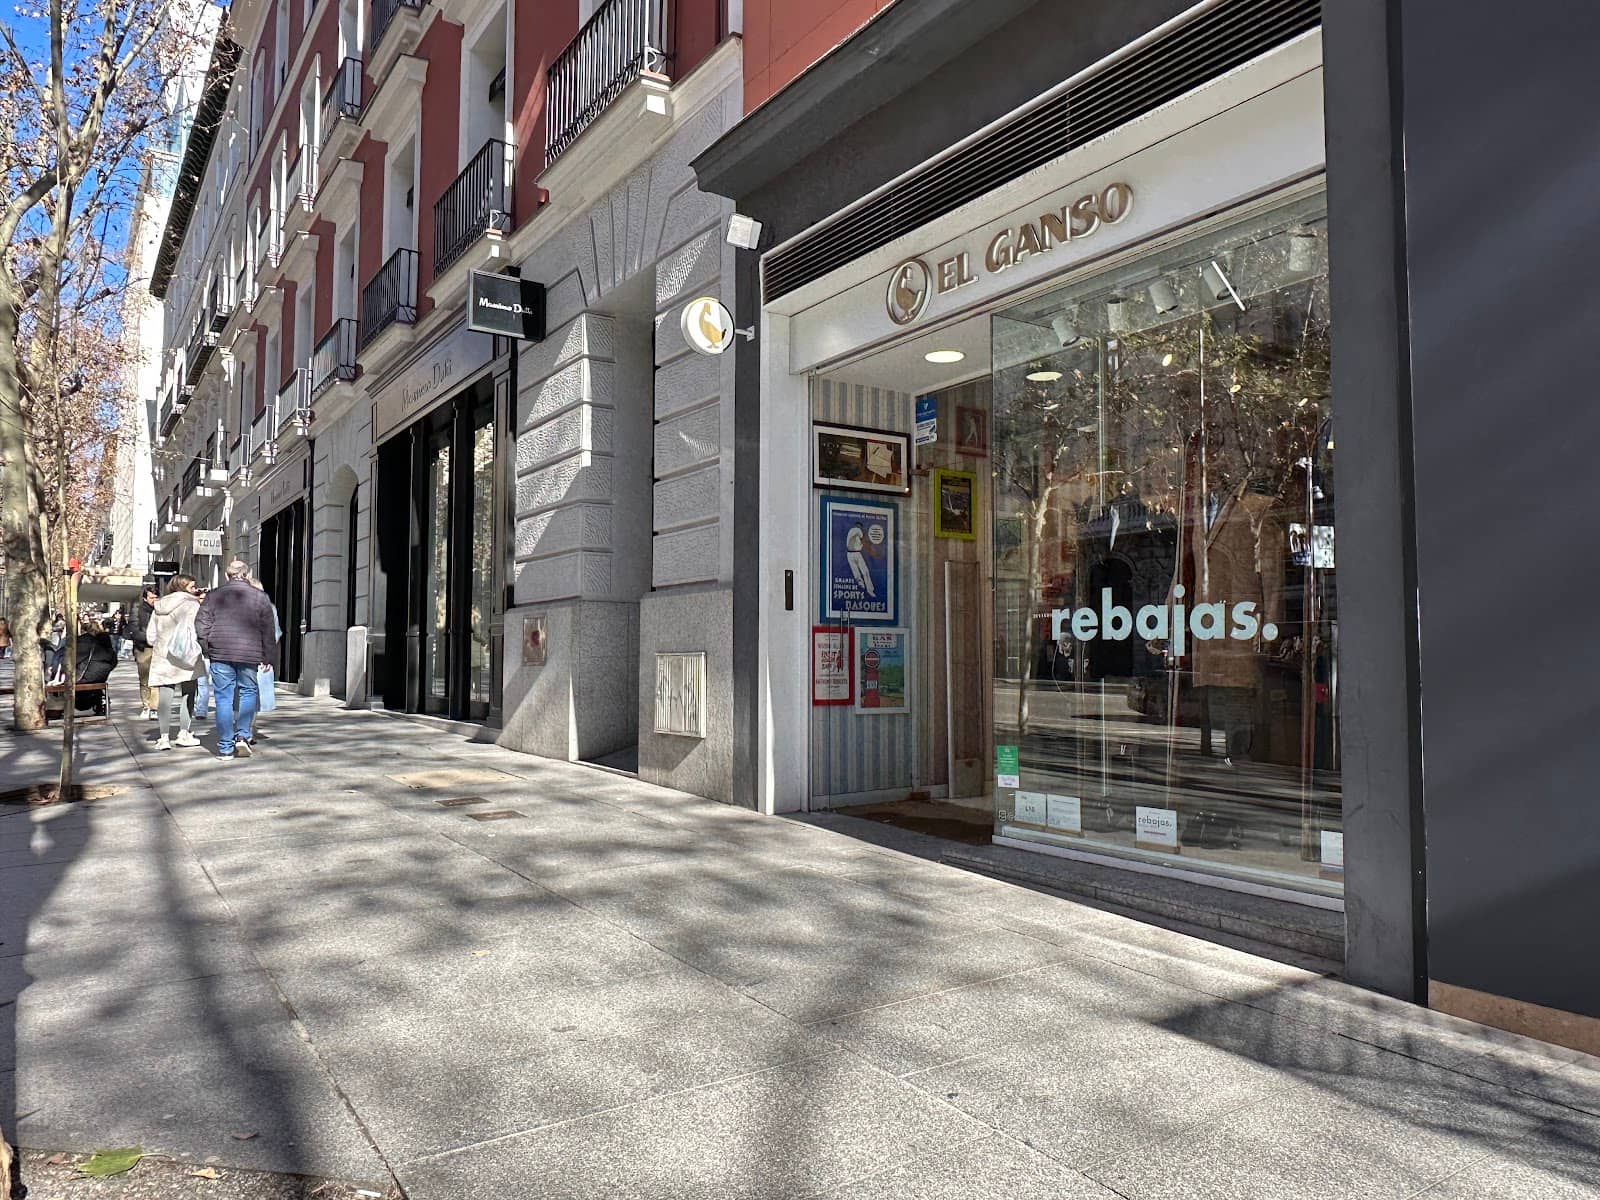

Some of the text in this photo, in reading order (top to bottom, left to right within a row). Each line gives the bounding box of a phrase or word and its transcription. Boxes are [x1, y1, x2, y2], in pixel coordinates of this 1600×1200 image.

[937, 182, 1135, 295] EL GANSO
[833, 590, 865, 600] SPORTS
[1051, 584, 1279, 657] rebajas.
